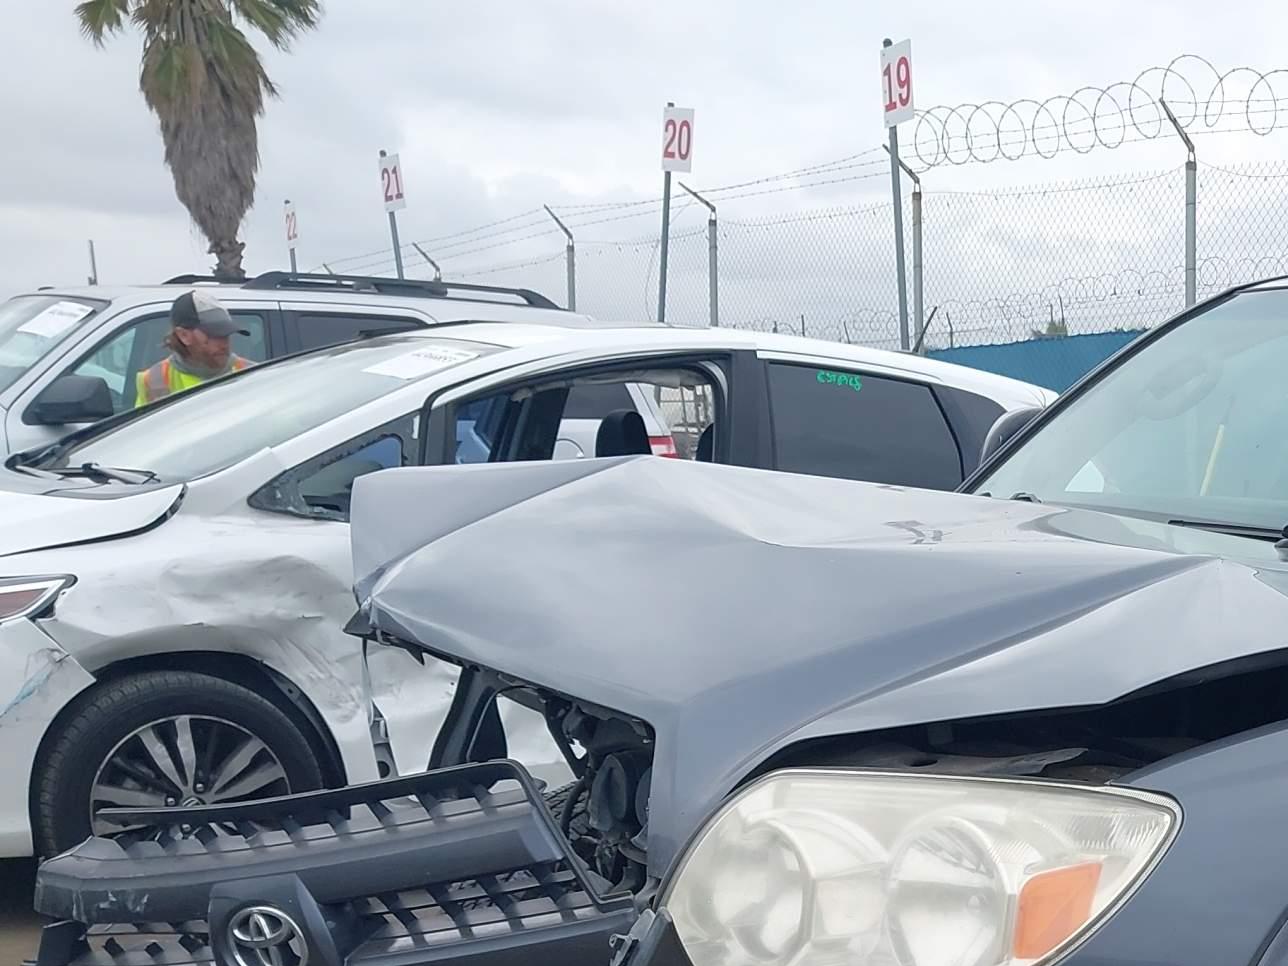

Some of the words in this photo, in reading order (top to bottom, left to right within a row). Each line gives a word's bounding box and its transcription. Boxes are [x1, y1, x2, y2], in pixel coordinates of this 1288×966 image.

[882, 56, 911, 113] 19
[663, 119, 691, 161] 20
[381, 165, 404, 203] 21
[285, 211, 298, 241] 22
